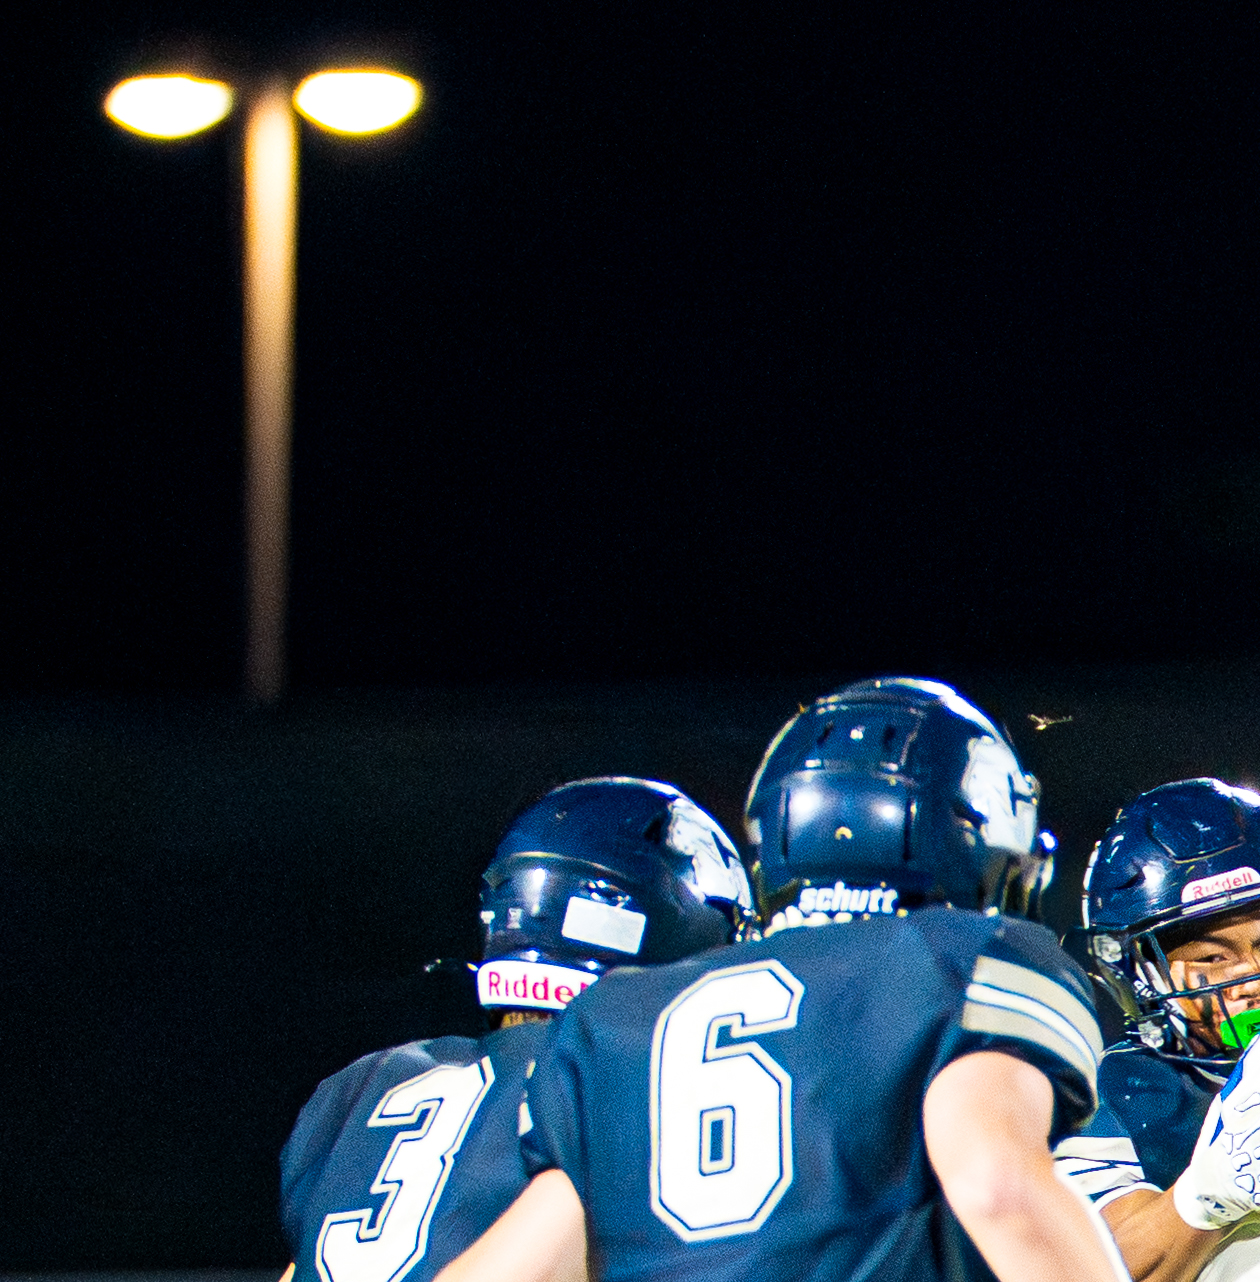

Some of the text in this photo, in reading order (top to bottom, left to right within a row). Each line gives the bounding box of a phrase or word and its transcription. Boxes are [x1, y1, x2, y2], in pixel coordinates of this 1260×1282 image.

[798, 881, 898, 914] schutt
[488, 970, 589, 1005] Ridde
[650, 958, 805, 1243] 6
